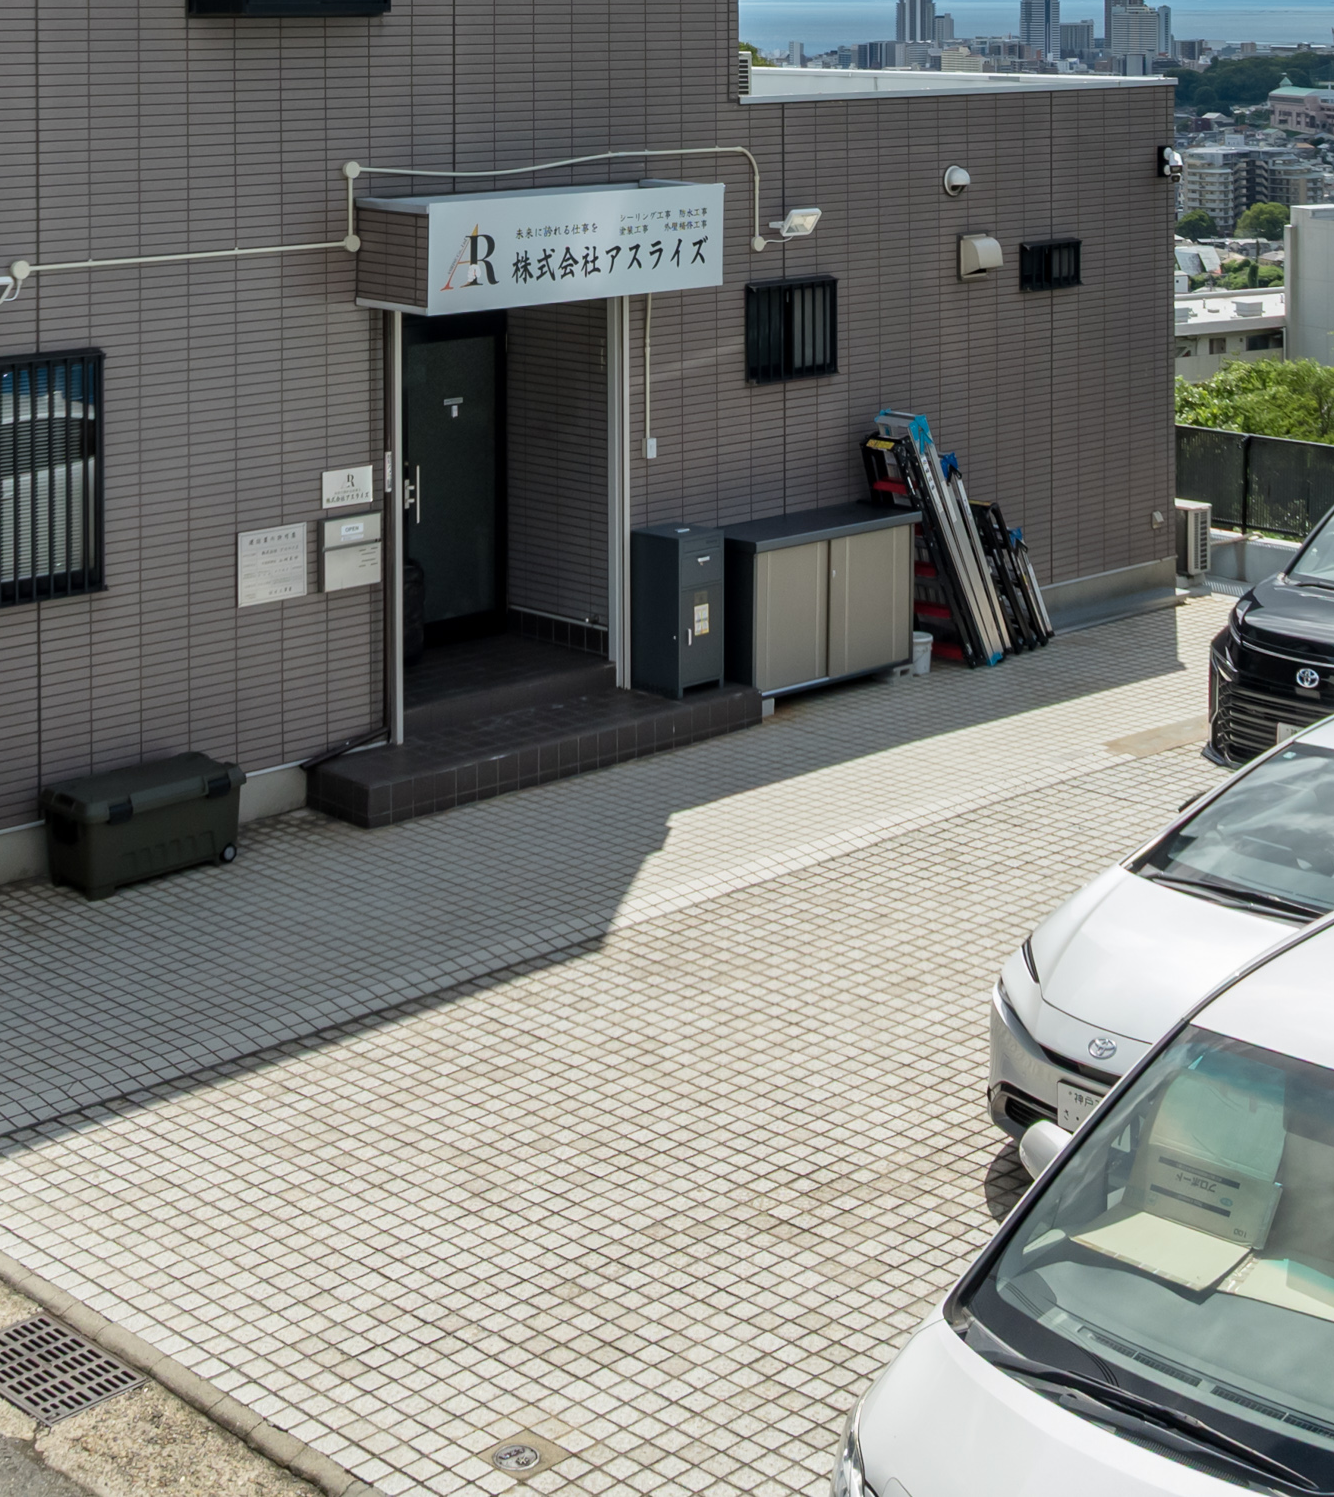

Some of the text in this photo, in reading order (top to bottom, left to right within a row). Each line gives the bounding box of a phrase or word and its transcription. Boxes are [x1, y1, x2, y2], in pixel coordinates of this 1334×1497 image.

[620, 207, 708, 222] シーリング工事 防水工事
[515, 222, 599, 240] 未来に誇れる仕事を
[619, 224, 649, 236] 塗装工事
[511, 235, 709, 284] 株式会社アスライズ
[344, 525, 359, 533] OPEN
[1175, 1172, 1217, 1193] プロボード
